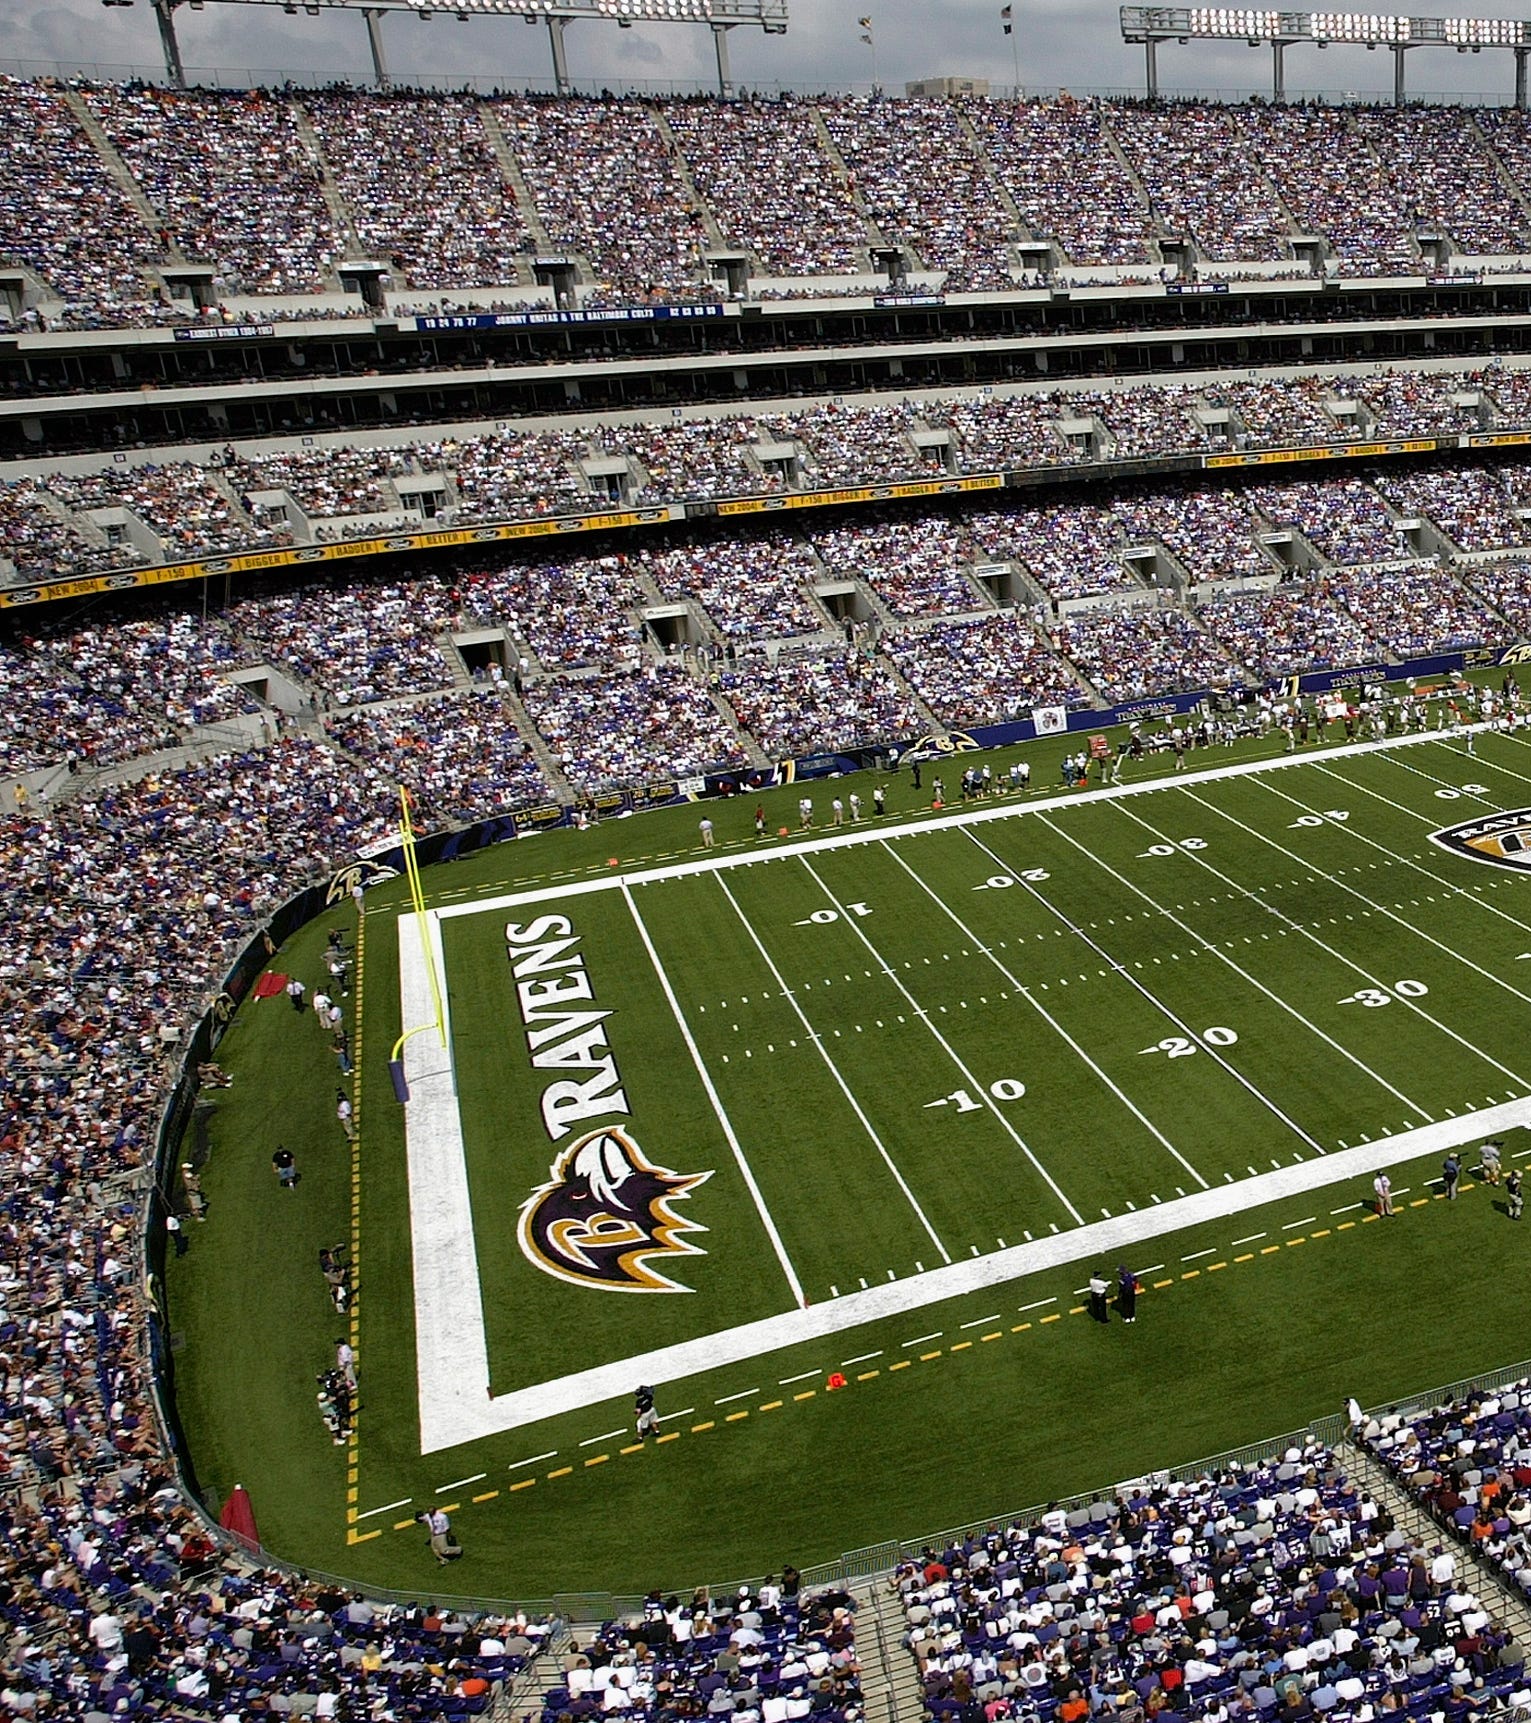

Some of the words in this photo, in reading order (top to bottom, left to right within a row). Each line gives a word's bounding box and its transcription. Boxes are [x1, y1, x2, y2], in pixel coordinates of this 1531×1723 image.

[50, 586, 71, 597] NEW
[244, 555, 281, 567] BIGGER
[1148, 836, 1208, 856] 30
[986, 867, 1050, 888] 20
[810, 901, 873, 923] 10
[1354, 979, 1428, 1007] 30
[505, 913, 633, 1141] RAVENS
[1158, 1026, 1239, 1058] 20
[947, 1079, 1026, 1112] 10
[1427, 1606, 1440, 1618] 52
